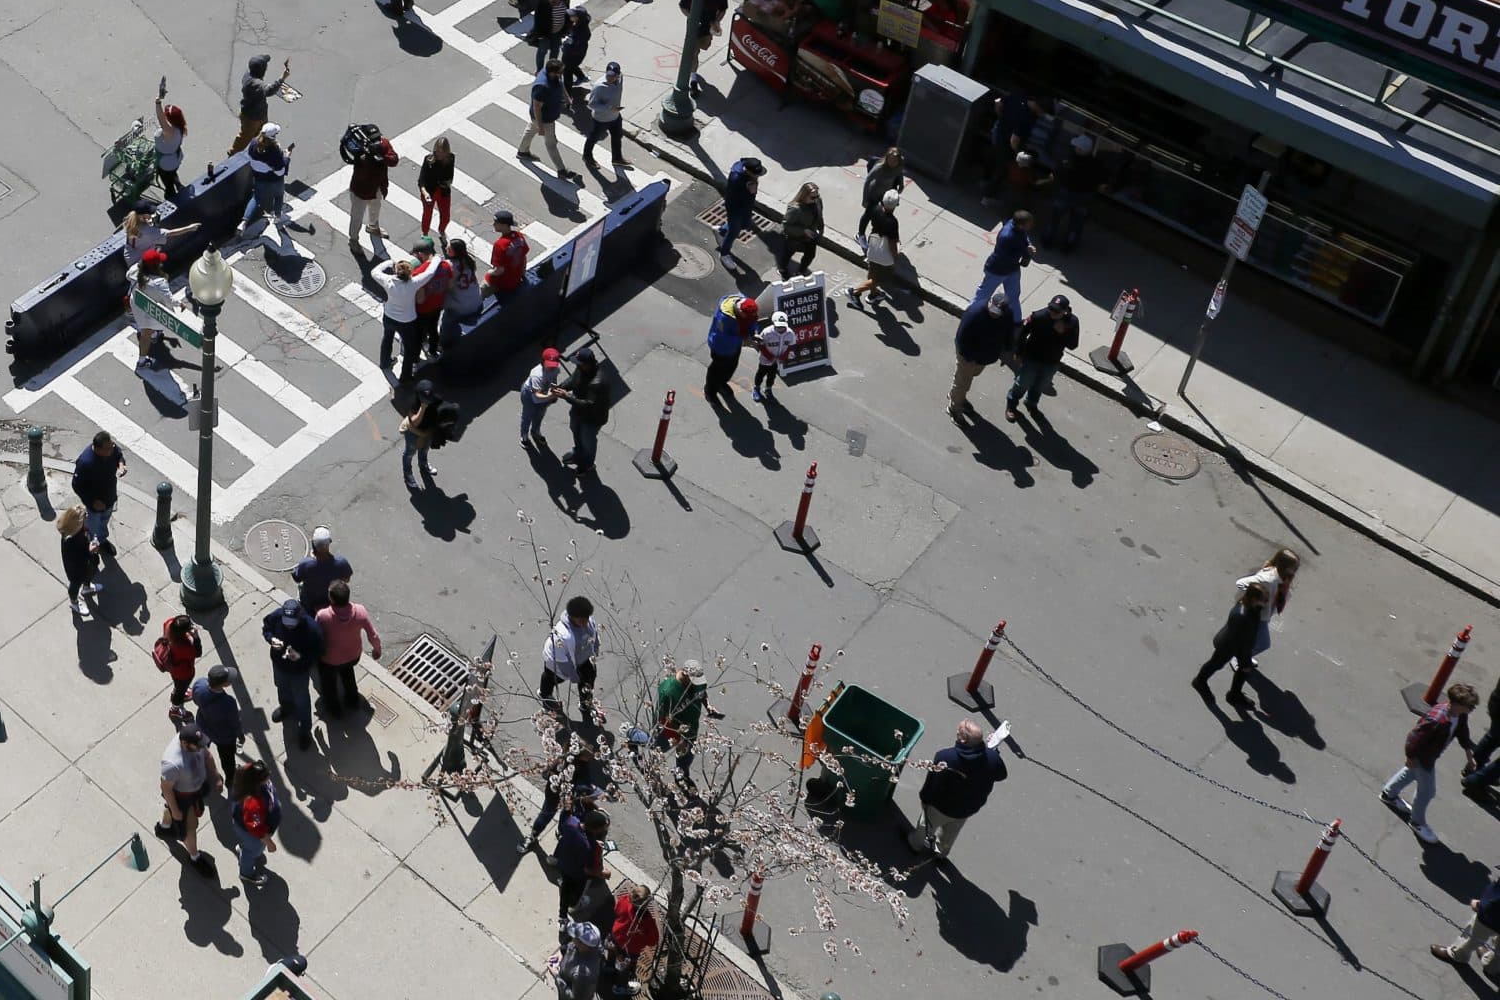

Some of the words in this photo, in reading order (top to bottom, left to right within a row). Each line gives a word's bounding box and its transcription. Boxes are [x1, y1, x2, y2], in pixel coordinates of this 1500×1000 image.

[741, 34, 781, 68] Coca-Cola
[783, 300, 795, 309] NO
[797, 293, 819, 306] BAGS
[786, 304, 818, 317] LARGER
[144, 302, 180, 333] JERSEY
[792, 313, 813, 326] THAN
[280, 528, 292, 563] BOSTON
[29, 954, 68, 990] AVENUE
